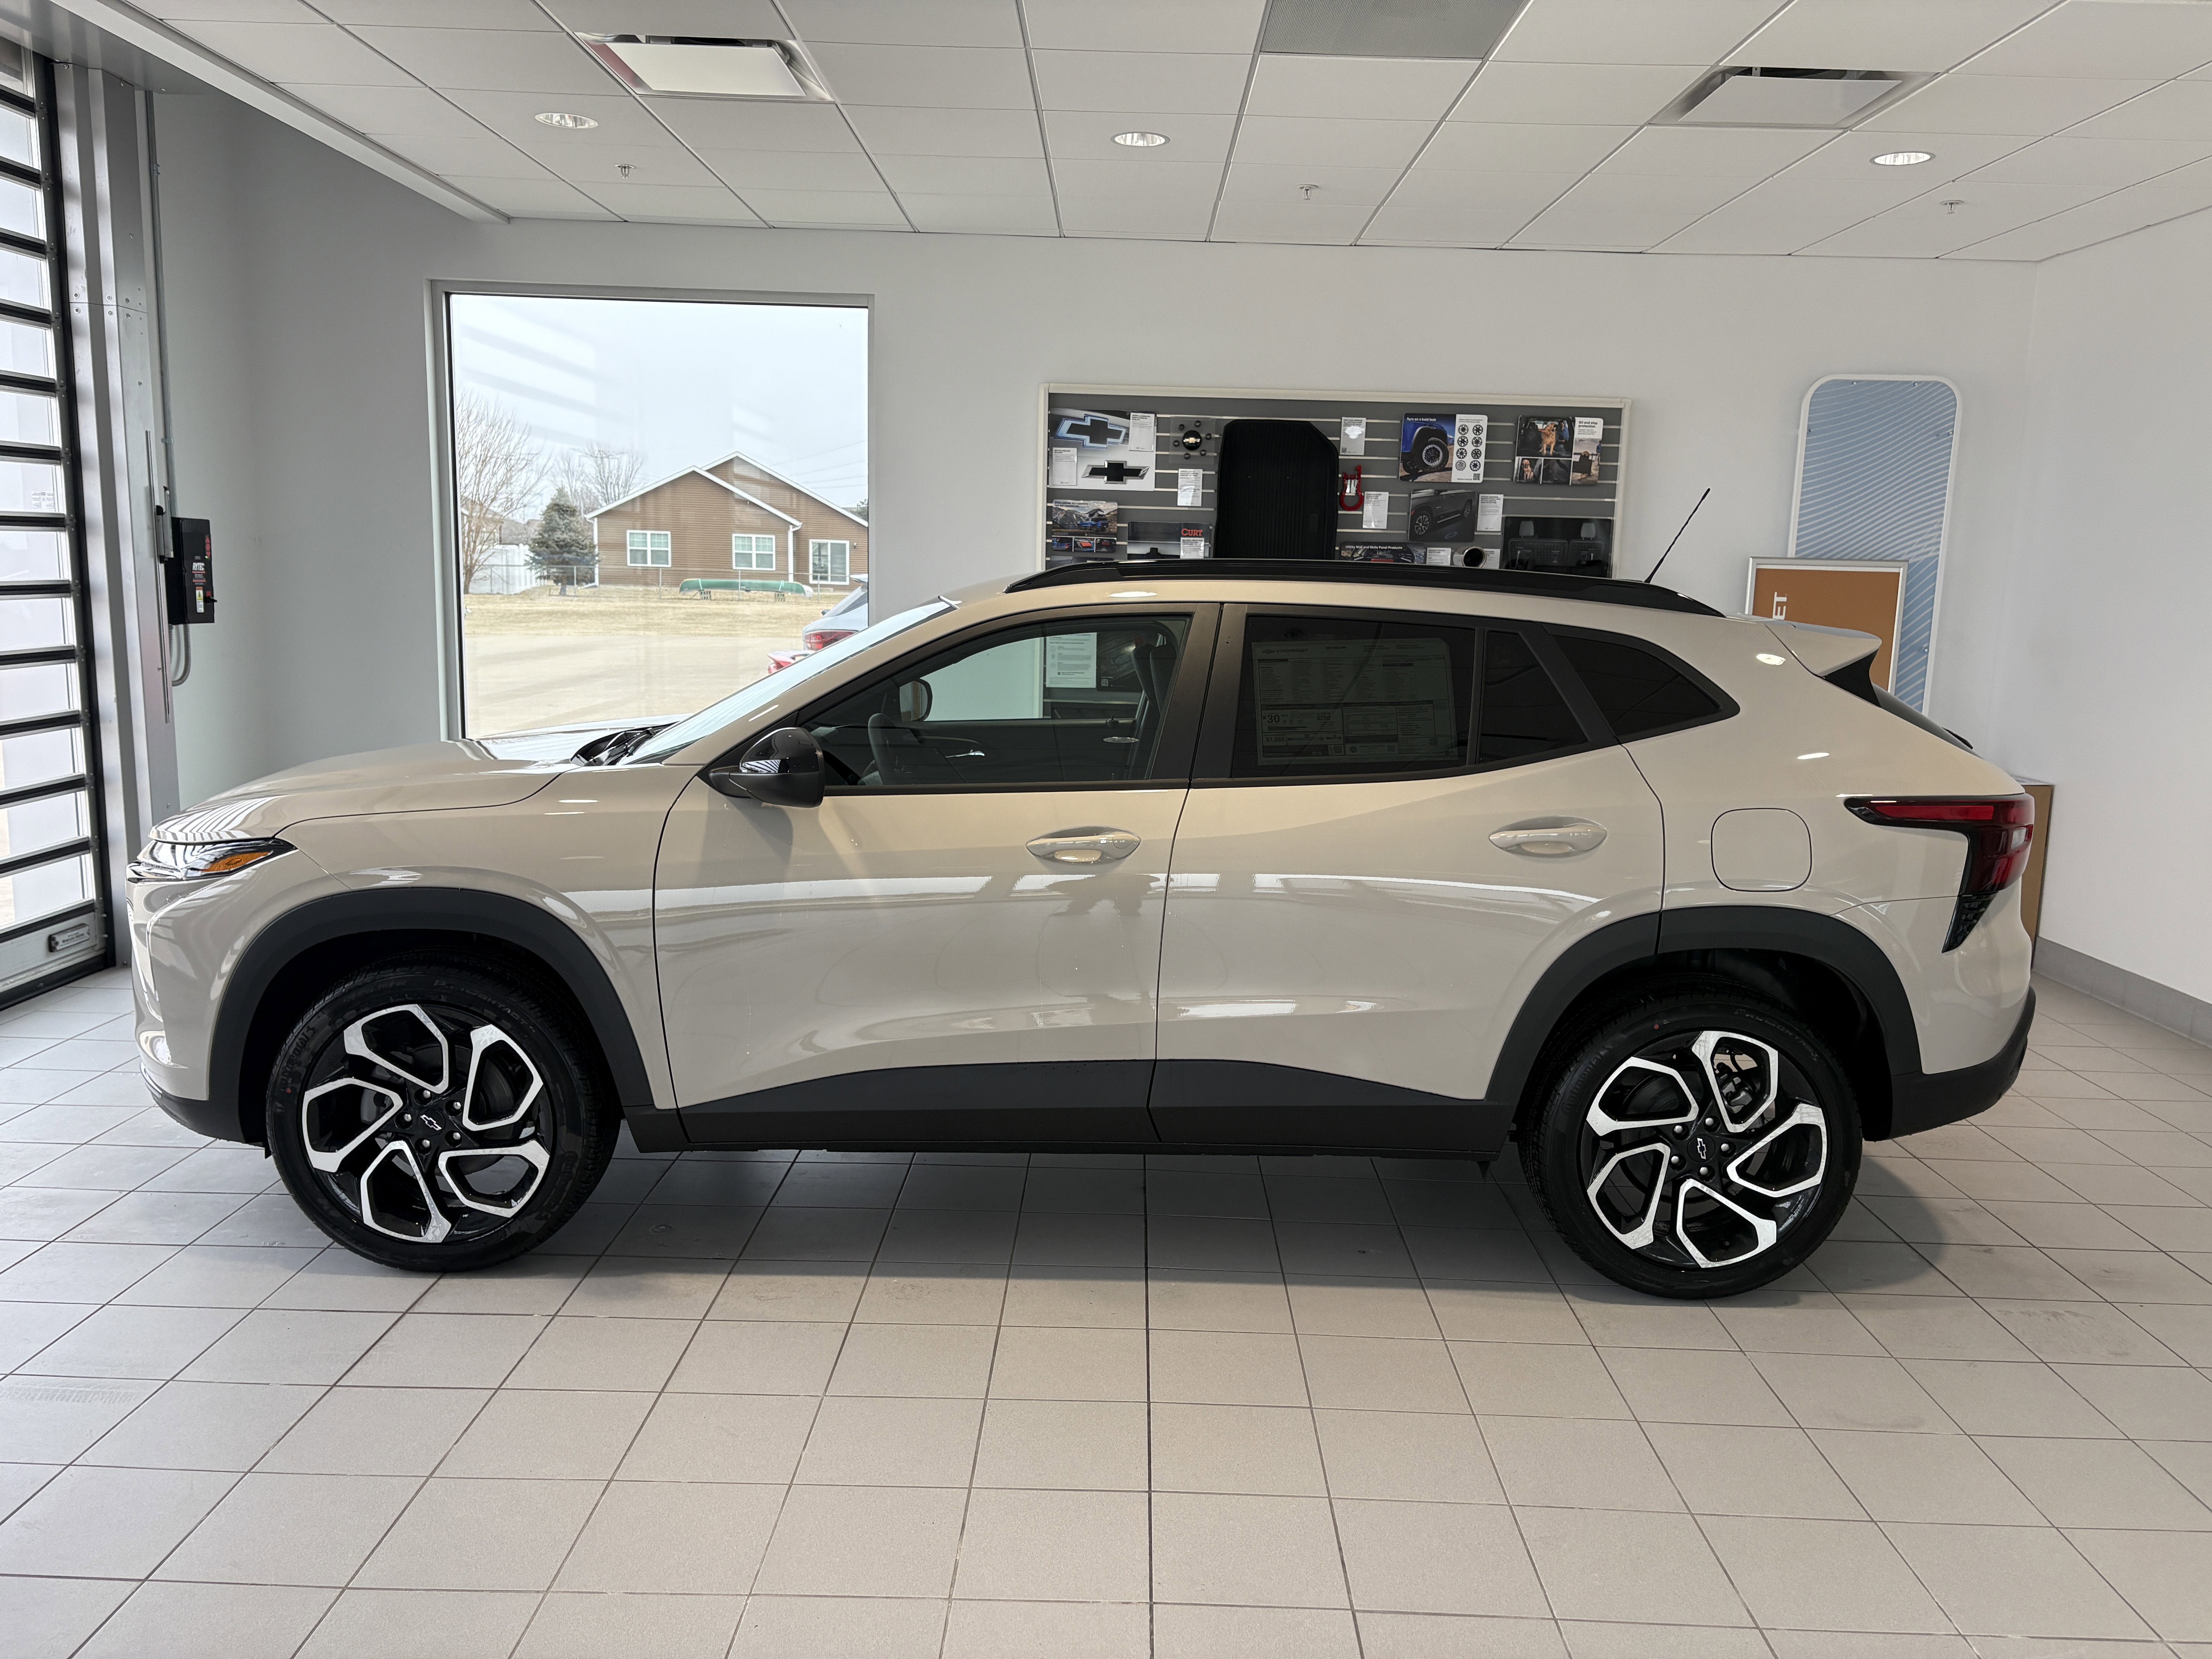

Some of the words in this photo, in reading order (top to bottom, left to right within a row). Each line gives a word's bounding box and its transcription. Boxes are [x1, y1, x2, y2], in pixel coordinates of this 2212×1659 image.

[1181, 528, 1202, 536] CURT
[192, 562, 205, 571] RYTEC
[1267, 714, 1280, 723] 30
